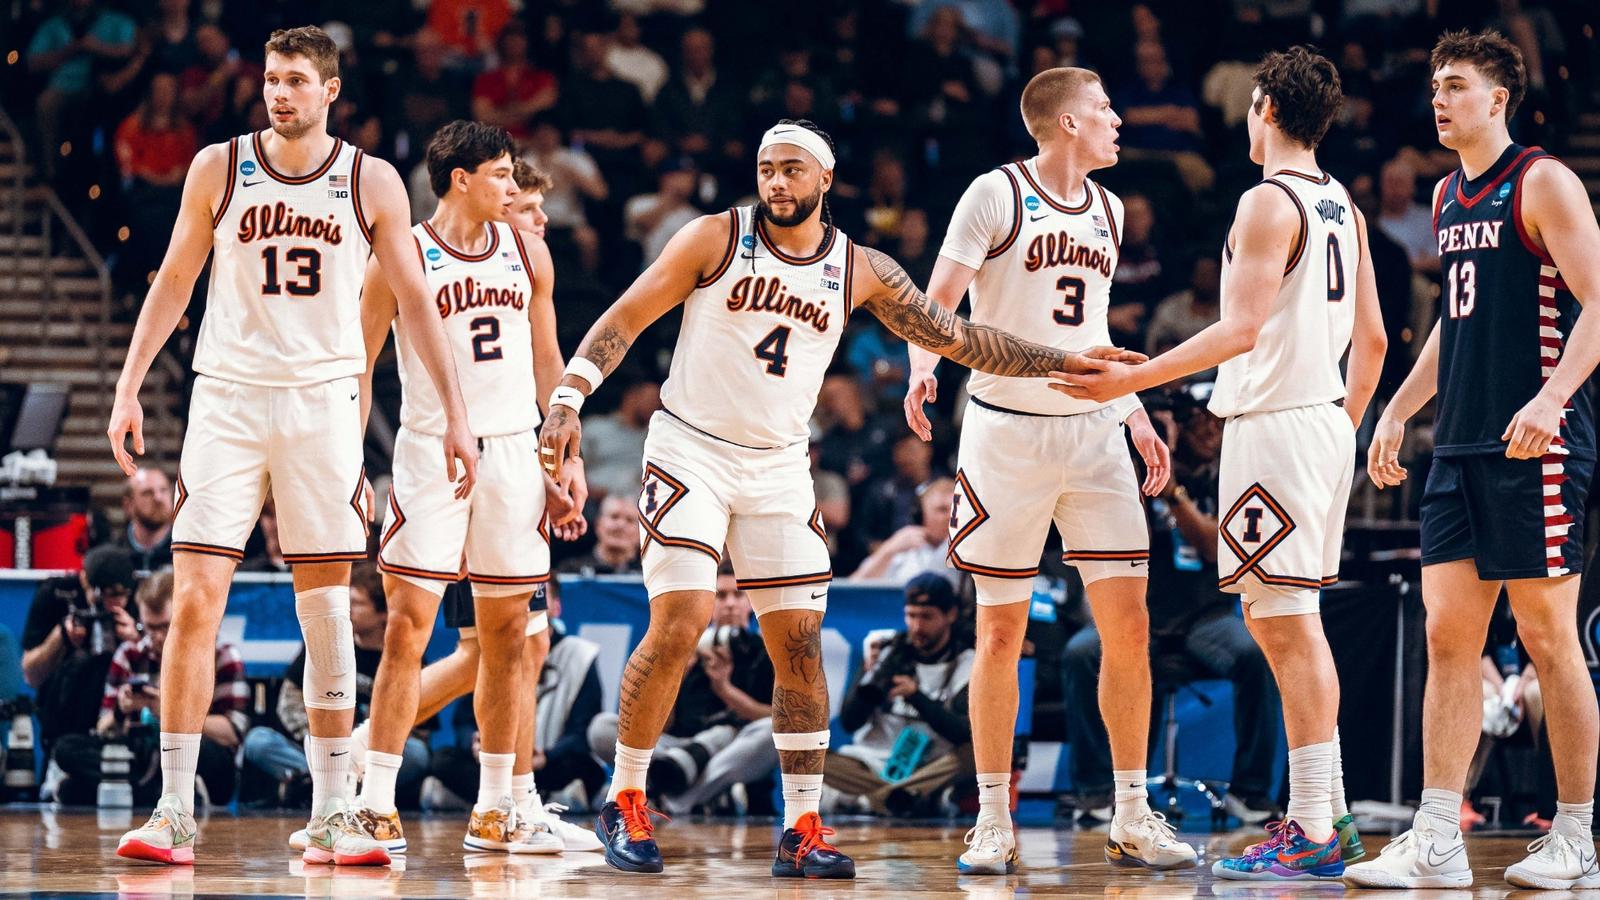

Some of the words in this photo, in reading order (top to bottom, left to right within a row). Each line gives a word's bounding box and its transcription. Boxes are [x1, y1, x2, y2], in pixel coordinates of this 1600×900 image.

[237, 200, 343, 247] Illinois
[1438, 220, 1504, 257] PENN
[261, 245, 321, 297] 13
[1024, 230, 1111, 278] Illinois
[1326, 231, 1346, 303] 0
[435, 276, 525, 320] Illinois
[726, 275, 831, 334] Illinois
[1052, 275, 1086, 327] 3
[1447, 260, 1476, 320] 13
[469, 315, 504, 362] 2
[752, 323, 792, 379] 4
[1242, 506, 1264, 544] I
